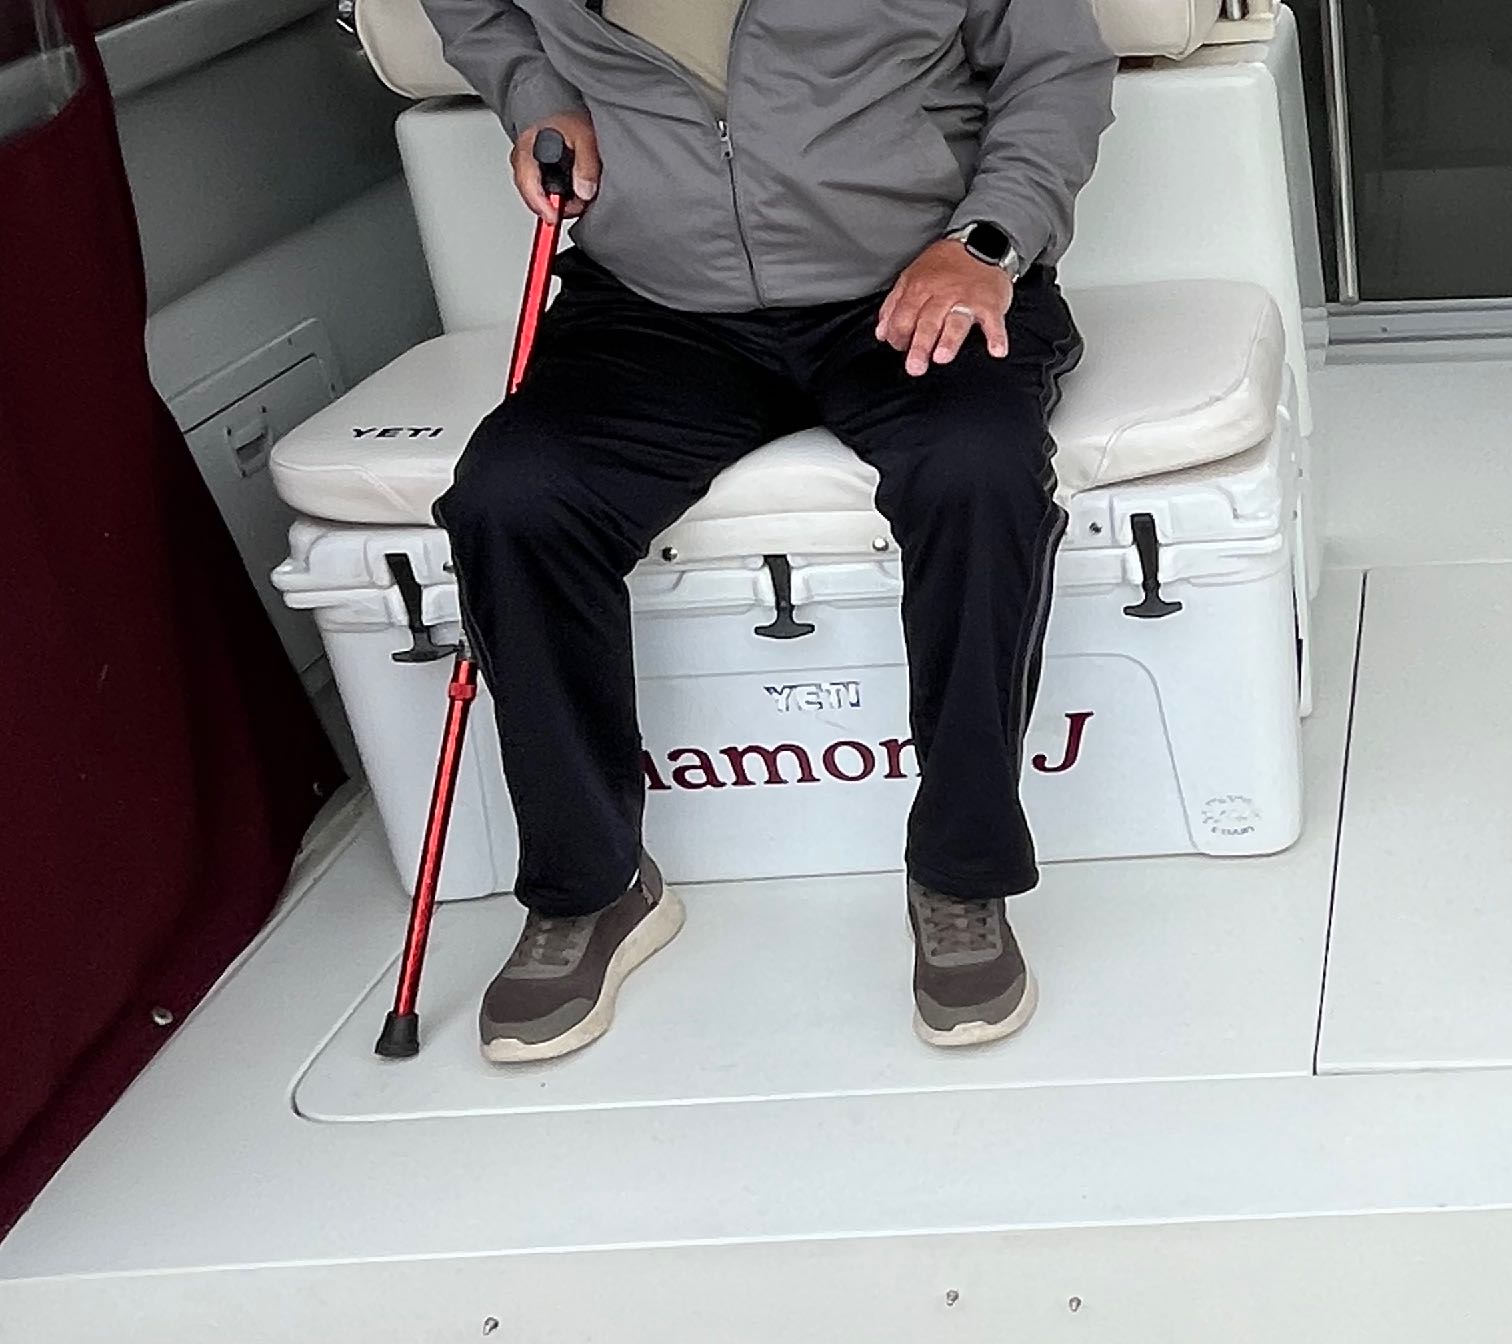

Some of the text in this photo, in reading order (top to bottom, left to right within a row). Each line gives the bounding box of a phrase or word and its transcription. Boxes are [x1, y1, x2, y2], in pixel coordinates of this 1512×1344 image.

[352, 426, 444, 438] YETI
[762, 680, 861, 712] YETI
[1031, 710, 1095, 774] J
